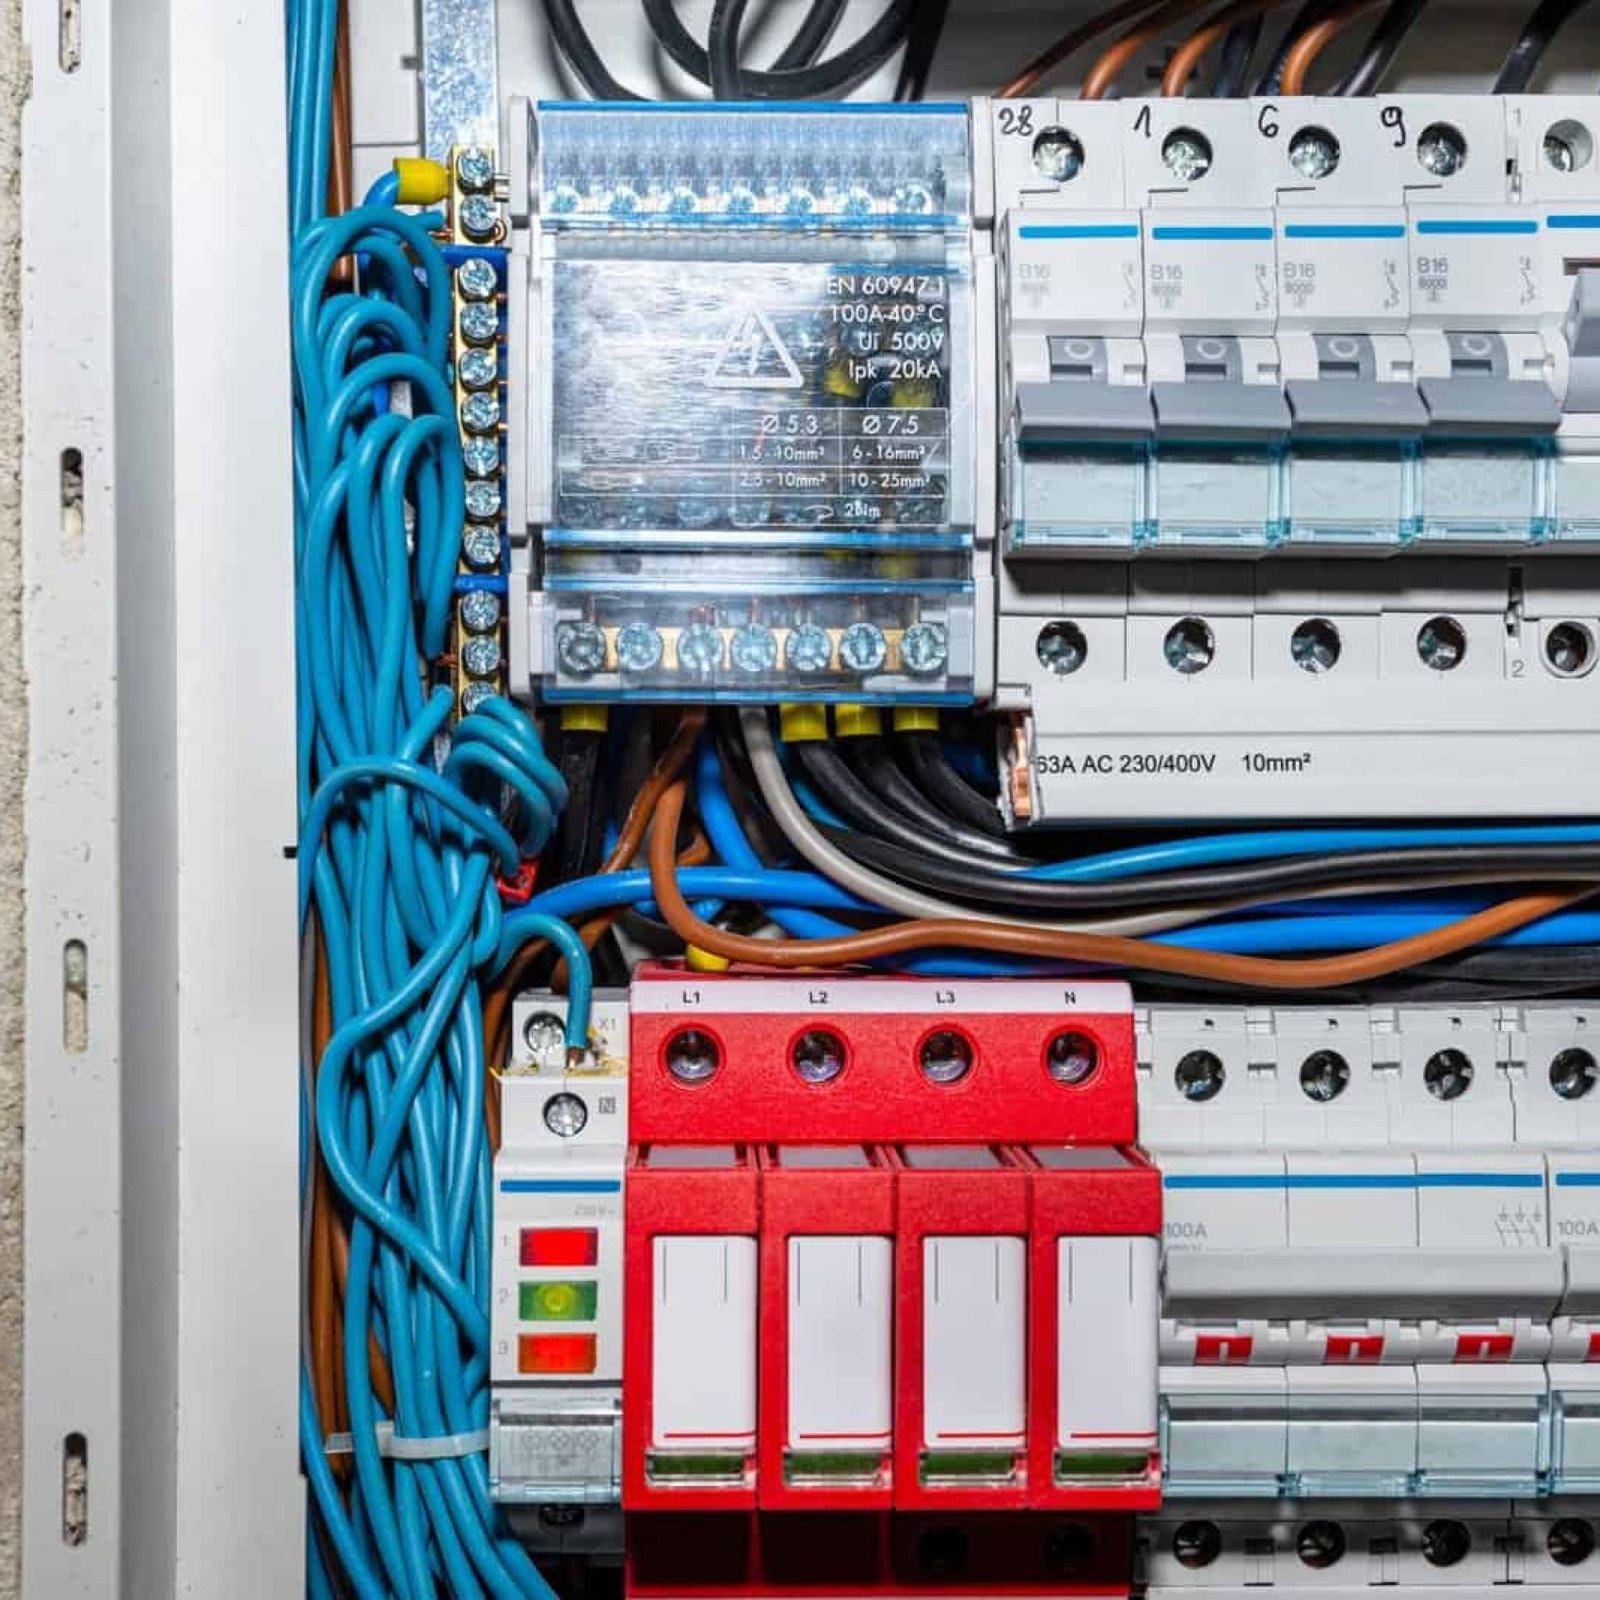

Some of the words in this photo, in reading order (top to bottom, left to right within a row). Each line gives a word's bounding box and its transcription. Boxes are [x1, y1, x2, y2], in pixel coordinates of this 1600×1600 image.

[998, 104, 1034, 136] 28
[1132, 104, 1152, 138] 1
[1257, 104, 1279, 138] 6
[1380, 105, 1407, 148] 9
[1018, 263, 1050, 279] B16
[1150, 263, 1183, 280] B16
[1283, 261, 1316, 279] B16
[1416, 256, 1448, 274] B16
[826, 275, 855, 295] EN
[891, 331, 944, 351] 500V
[849, 359, 877, 384] Ipk
[890, 359, 942, 380] 20kA
[887, 414, 919, 435] 7.5
[1511, 660, 1528, 678] 2
[1082, 754, 1113, 774] AC
[1120, 754, 1216, 774] 230/400V
[1243, 753, 1312, 773] 10mm²
[682, 991, 701, 1004] L1
[809, 991, 828, 1004] L2
[936, 991, 956, 1004] L3
[1064, 991, 1077, 1004] N
[1166, 1222, 1208, 1238] 100A
[1557, 1220, 1600, 1237] 100A
